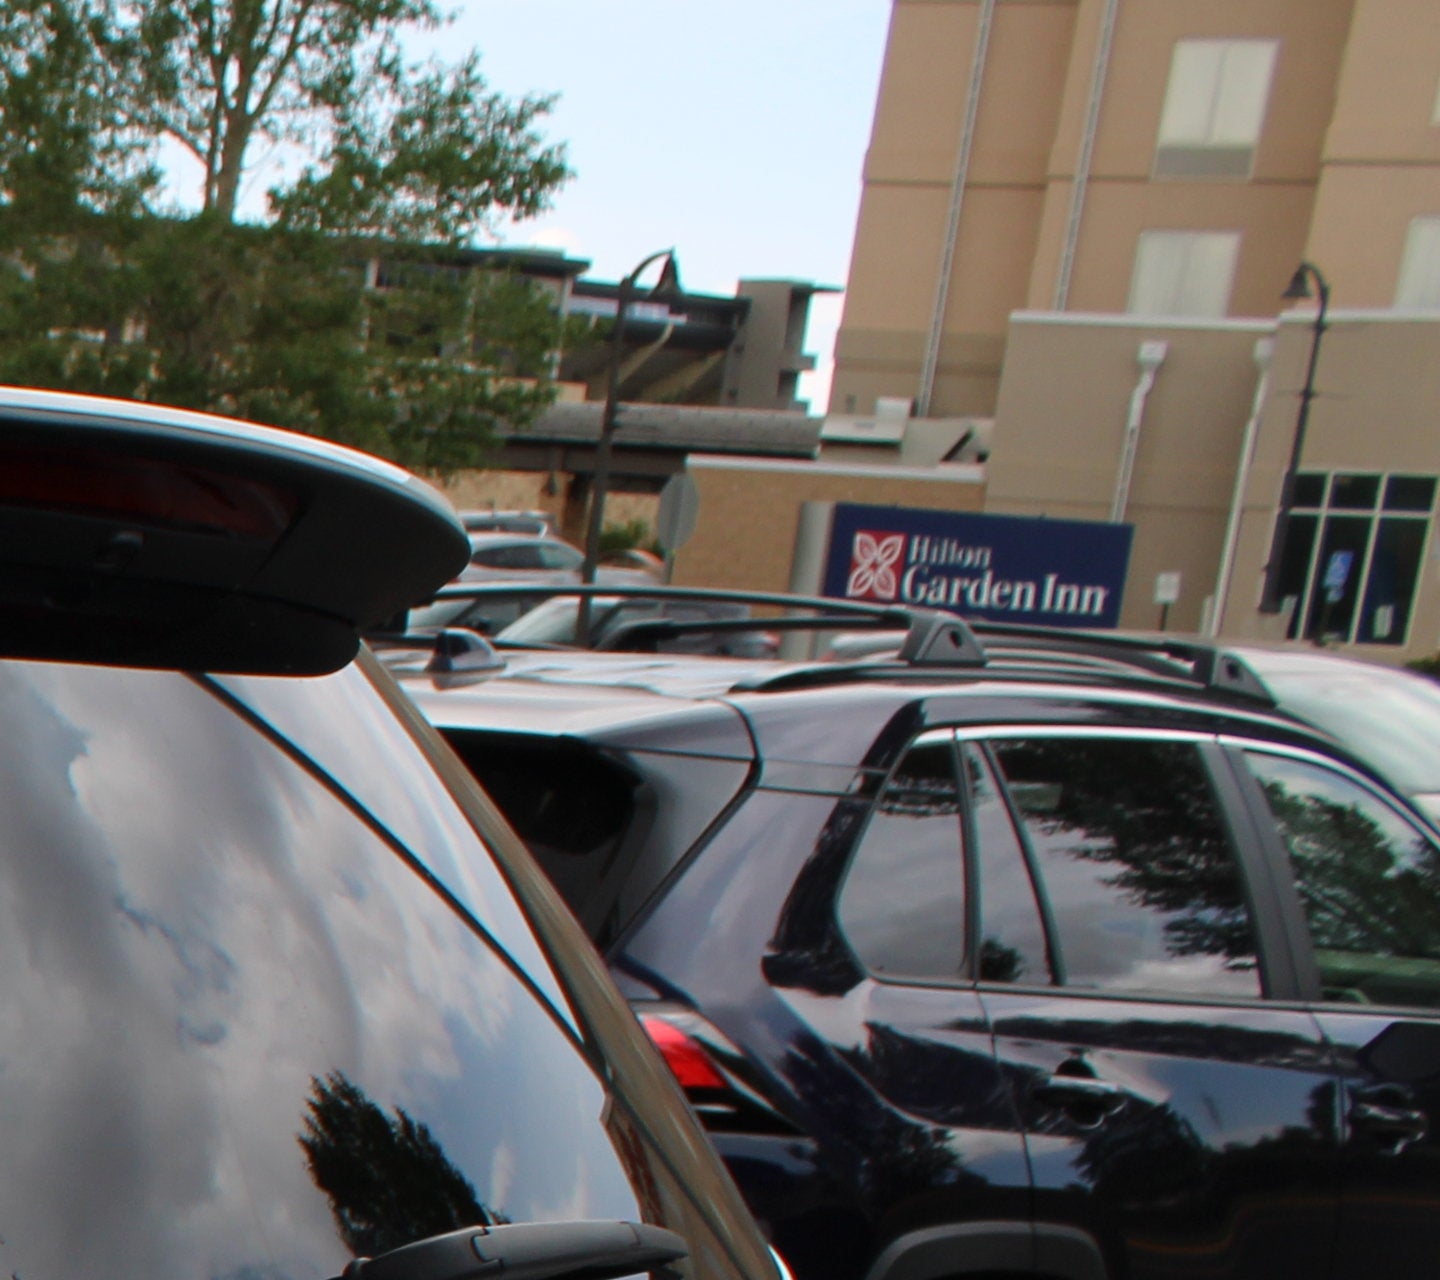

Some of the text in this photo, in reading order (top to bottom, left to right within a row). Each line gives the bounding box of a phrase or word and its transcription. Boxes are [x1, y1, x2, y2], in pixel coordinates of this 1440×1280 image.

[906, 534, 993, 568] Hilton
[900, 563, 1109, 616] Garden Inn
